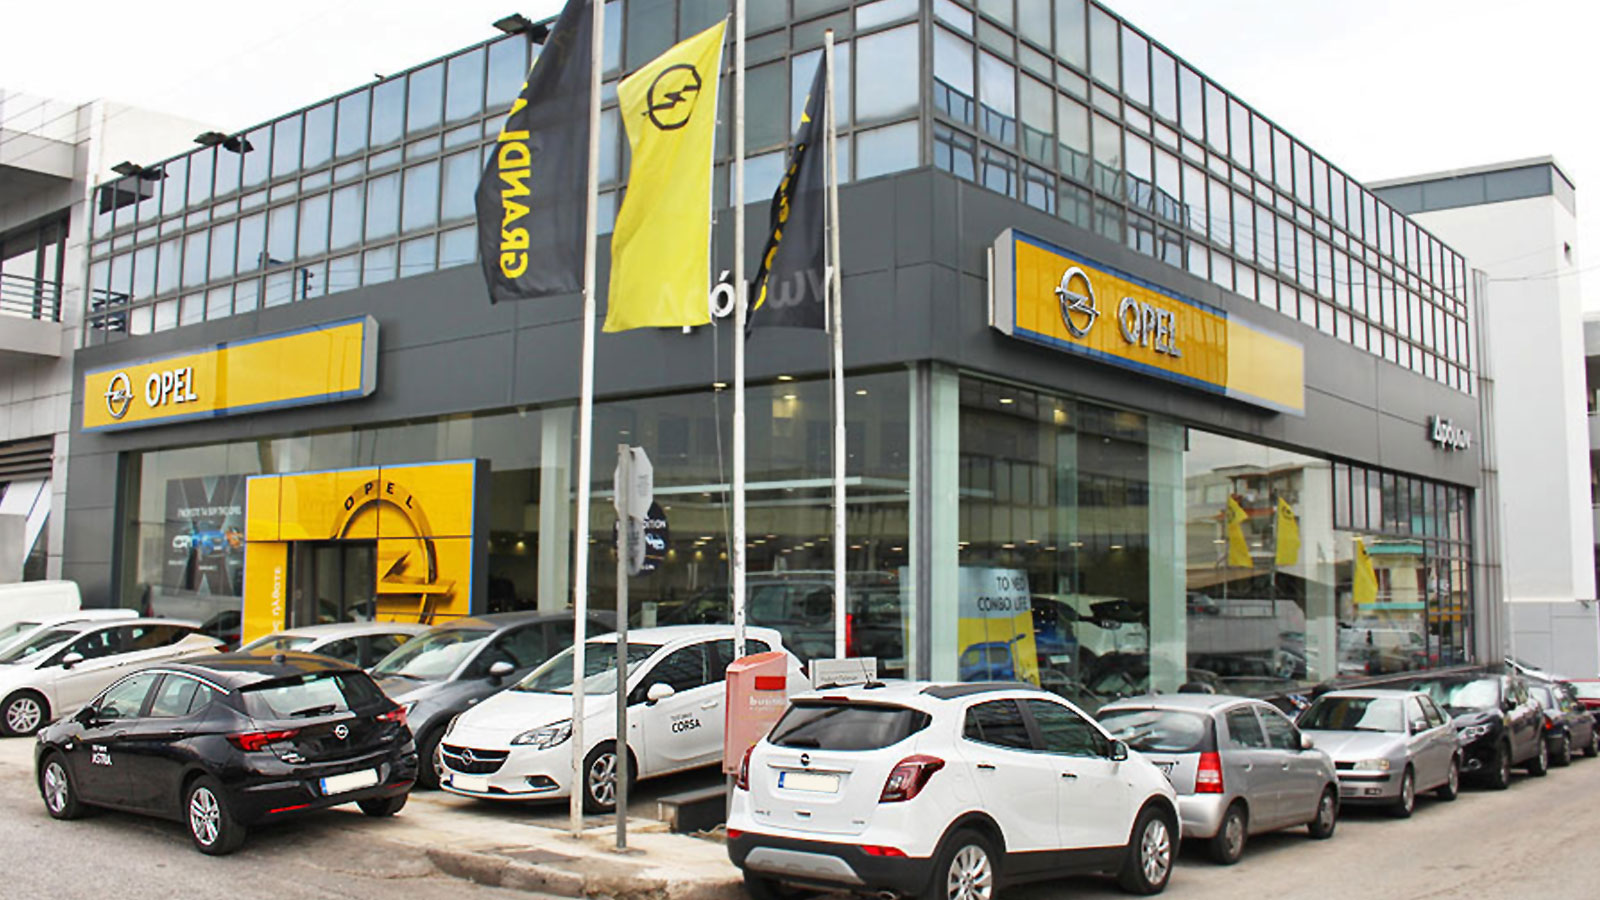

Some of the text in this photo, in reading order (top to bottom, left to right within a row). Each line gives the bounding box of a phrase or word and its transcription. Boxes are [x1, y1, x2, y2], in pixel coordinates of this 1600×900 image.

[1117, 297, 1182, 358] OPEL
[145, 366, 198, 407] OPEL
[344, 481, 413, 511] OPEL
[671, 718, 701, 733] CORSA
